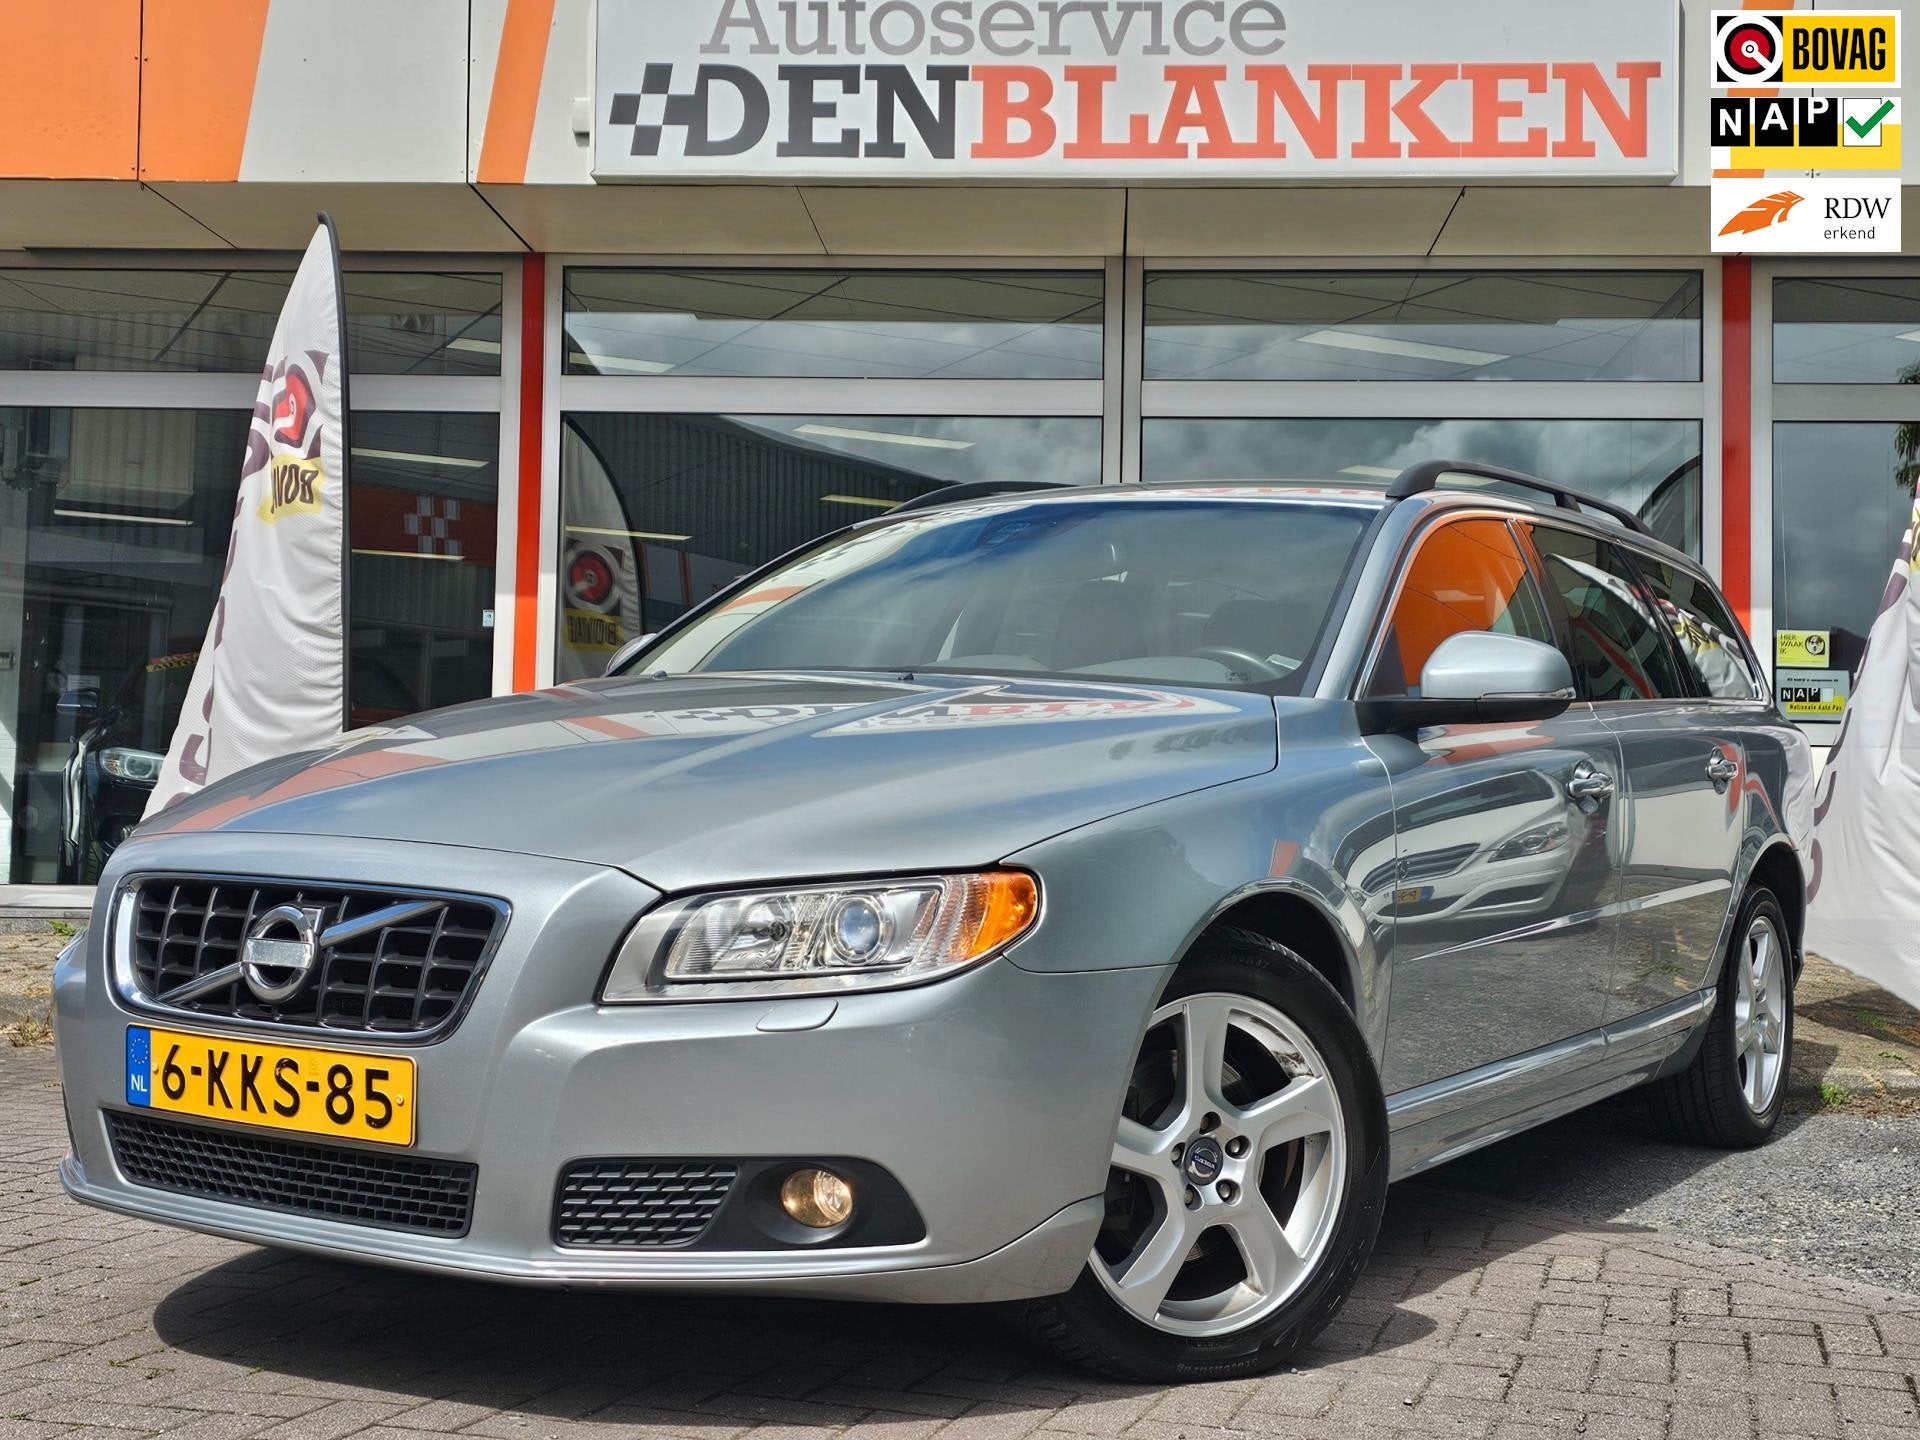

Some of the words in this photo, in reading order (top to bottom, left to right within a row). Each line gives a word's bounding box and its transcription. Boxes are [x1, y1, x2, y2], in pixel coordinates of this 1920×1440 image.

[699, 0, 1286, 56] Autoservice
[1782, 687, 1819, 700] NAP
[130, 1074, 148, 1092] NL
[162, 1043, 393, 1130] 6-KKS-85
